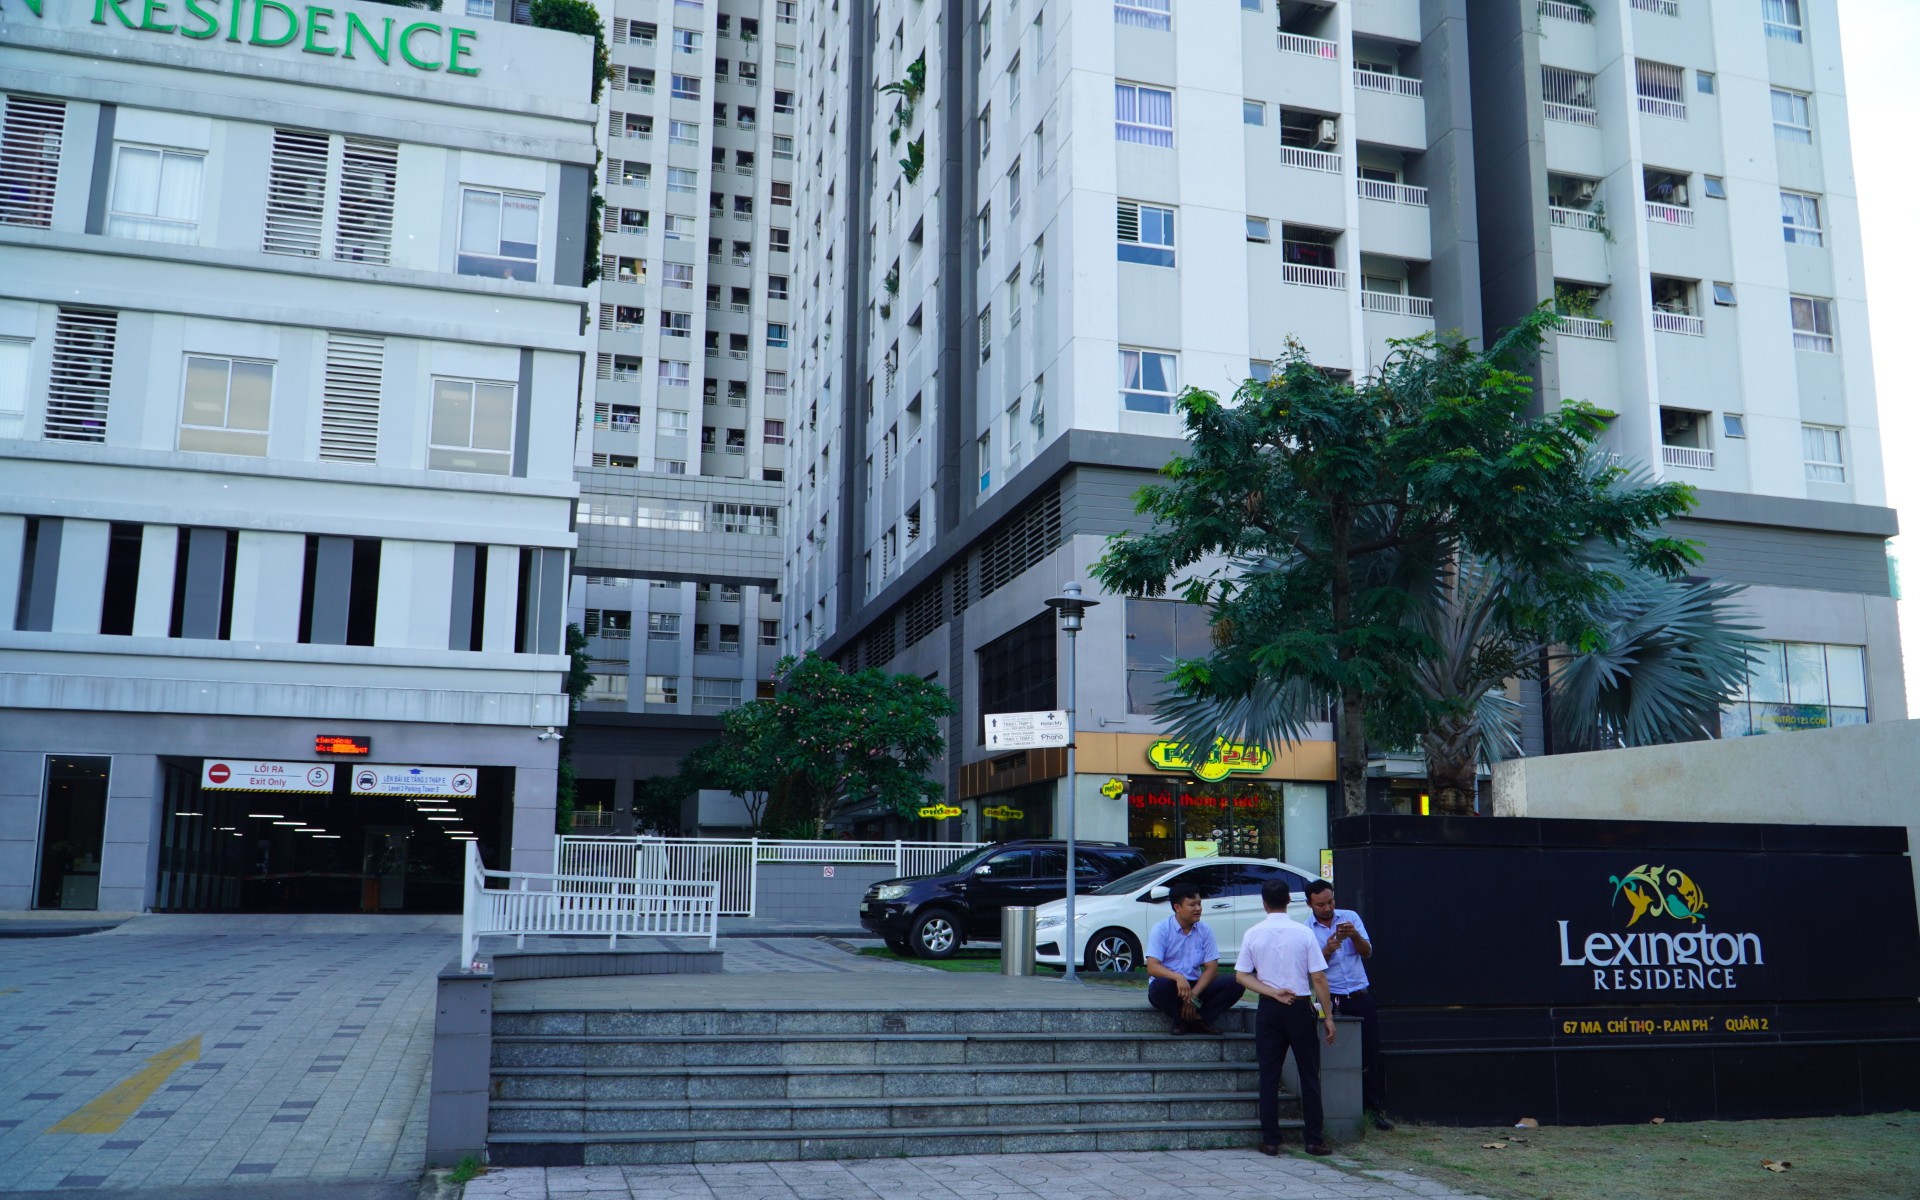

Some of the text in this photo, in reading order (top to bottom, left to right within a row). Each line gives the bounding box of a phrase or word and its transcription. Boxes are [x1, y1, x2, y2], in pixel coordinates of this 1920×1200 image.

[90, 0, 481, 77] RESIDENCE
[254, 763, 269, 773] LỐI
[315, 771, 322, 779] 5
[250, 777, 286, 787] Exit Only
[1557, 921, 1764, 967] Lexington
[1594, 968, 1736, 990] RESIDENCE
[1563, 1021, 1577, 1033] 67
[1607, 1017, 1628, 1033] CHÍ
[1629, 1020, 1655, 1035] THỌ
[1761, 1018, 1768, 1030] 2
